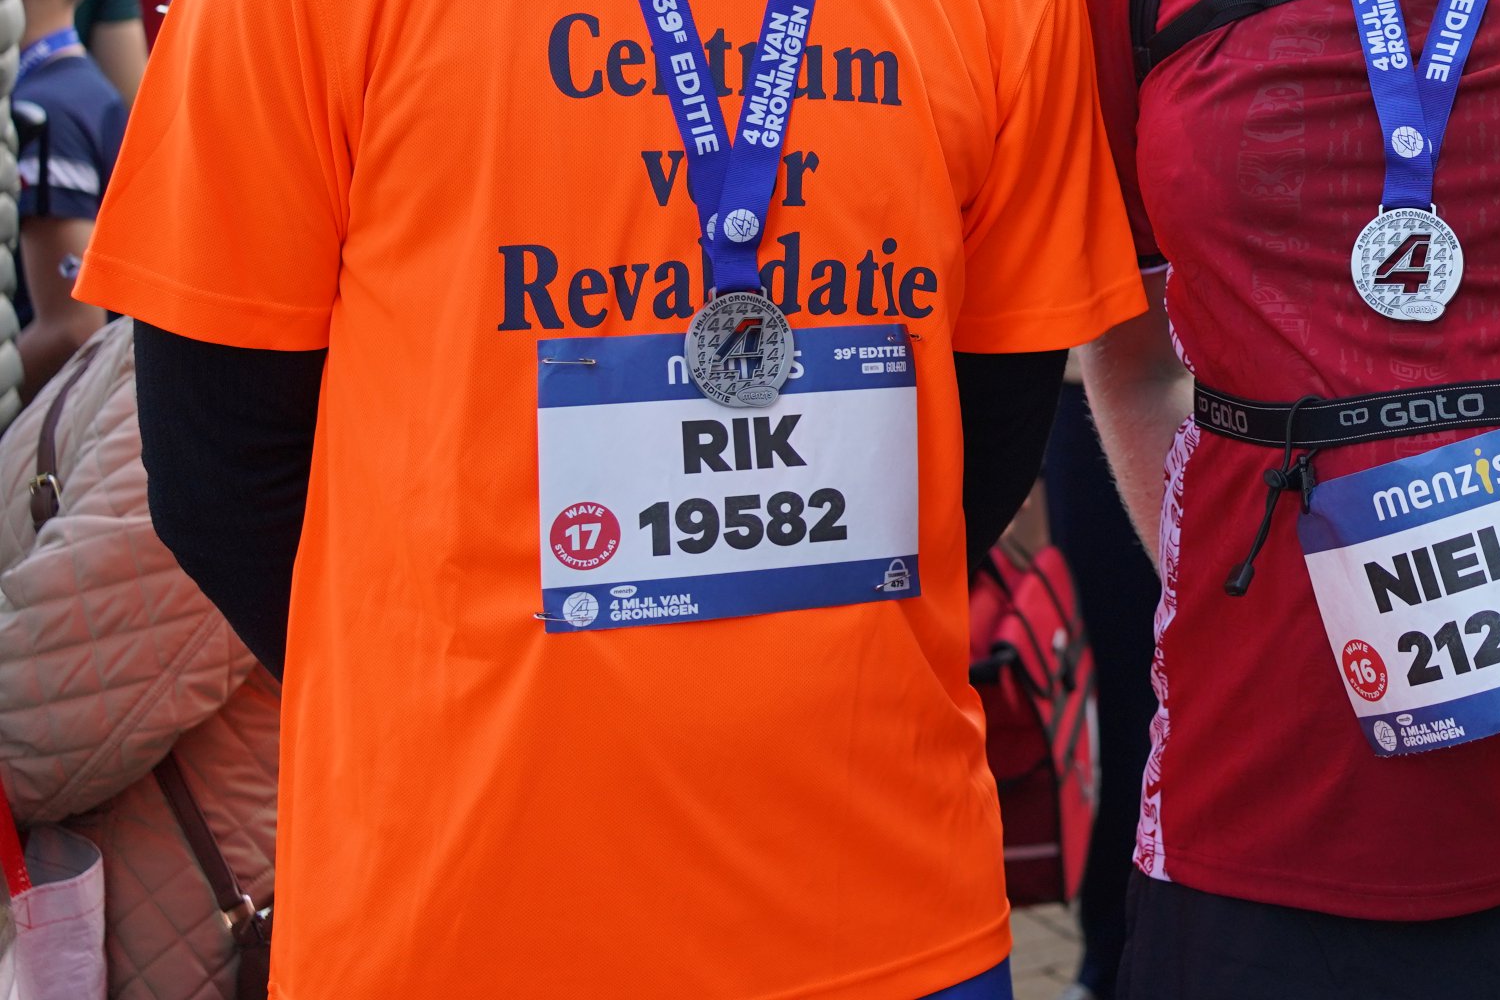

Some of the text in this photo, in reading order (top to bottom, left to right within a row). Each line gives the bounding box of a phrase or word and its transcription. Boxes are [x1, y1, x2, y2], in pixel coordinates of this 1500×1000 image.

[1363, 5, 1387, 55] MIJL
[548, 12, 903, 106] Cetum
[1373, 57, 1389, 71] 4
[742, 12, 789, 145] 4 MIJL VAN
[761, 5, 810, 148] GRONINGEN
[670, 52, 720, 155] EDITIE
[641, 150, 820, 207] vr
[1360, 225, 1376, 244] MIJL
[1375, 213, 1394, 226] VAN
[1395, 210, 1447, 231] GRONINGEN
[1444, 230, 1459, 251] 2026
[1373, 232, 1432, 295] 4
[497, 232, 938, 332] Revadatie
[695, 311, 711, 331] MIJL
[710, 298, 727, 311] VAN
[728, 294, 778, 317] GRONINGEN
[776, 314, 790, 334] 2026
[1365, 294, 1395, 316] EDITIE
[1405, 304, 1438, 316] menzis
[710, 316, 764, 382] 4
[833, 346, 906, 360] 39E EDITIE
[886, 361, 906, 373] GOLAZO
[702, 382, 732, 403] EDITIE
[742, 390, 773, 401] menzis
[681, 414, 808, 475] RIK
[565, 505, 605, 519] WAVE
[638, 487, 848, 557] 19582
[565, 522, 602, 551] 17
[555, 539, 617, 568] STARTTIJD 14.45
[610, 594, 691, 610] 4 MIJL VAN
[610, 604, 699, 621] GRONINGEN
[1345, 642, 1369, 655] WAVE
[1350, 658, 1377, 685] 16
[1350, 678, 1380, 699] STARTTIJD
[1400, 717, 1456, 737] 4 MIJL VAN
[1403, 726, 1466, 747] GRONINGEN
